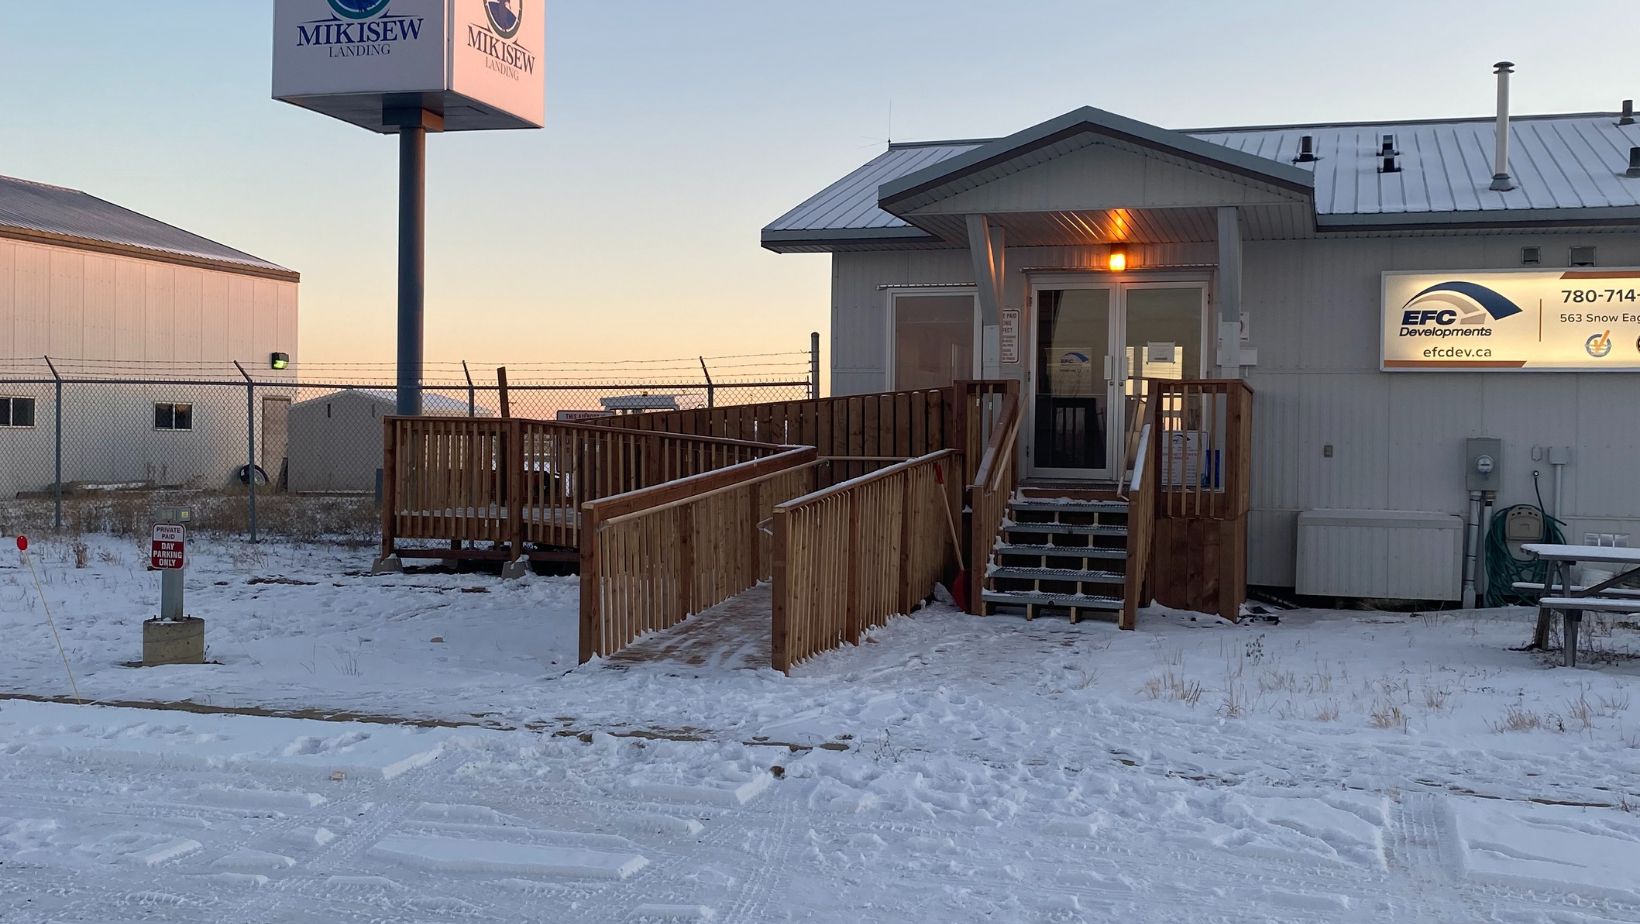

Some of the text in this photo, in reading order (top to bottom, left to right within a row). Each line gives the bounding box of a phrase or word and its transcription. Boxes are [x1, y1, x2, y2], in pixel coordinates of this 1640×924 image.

[296, 18, 424, 47] MIKISEW
[328, 44, 391, 58] LANDING
[467, 25, 535, 75] MIKISEW
[485, 56, 519, 81] LANDING
[1401, 310, 1457, 325] EFC
[1560, 313, 1583, 323] 563
[1586, 313, 1619, 323] Snow
[1399, 327, 1493, 338] Developments
[1423, 346, 1492, 357] efcdev.ca
[161, 542, 175, 550] DAY
[153, 550, 182, 558] PARKING
